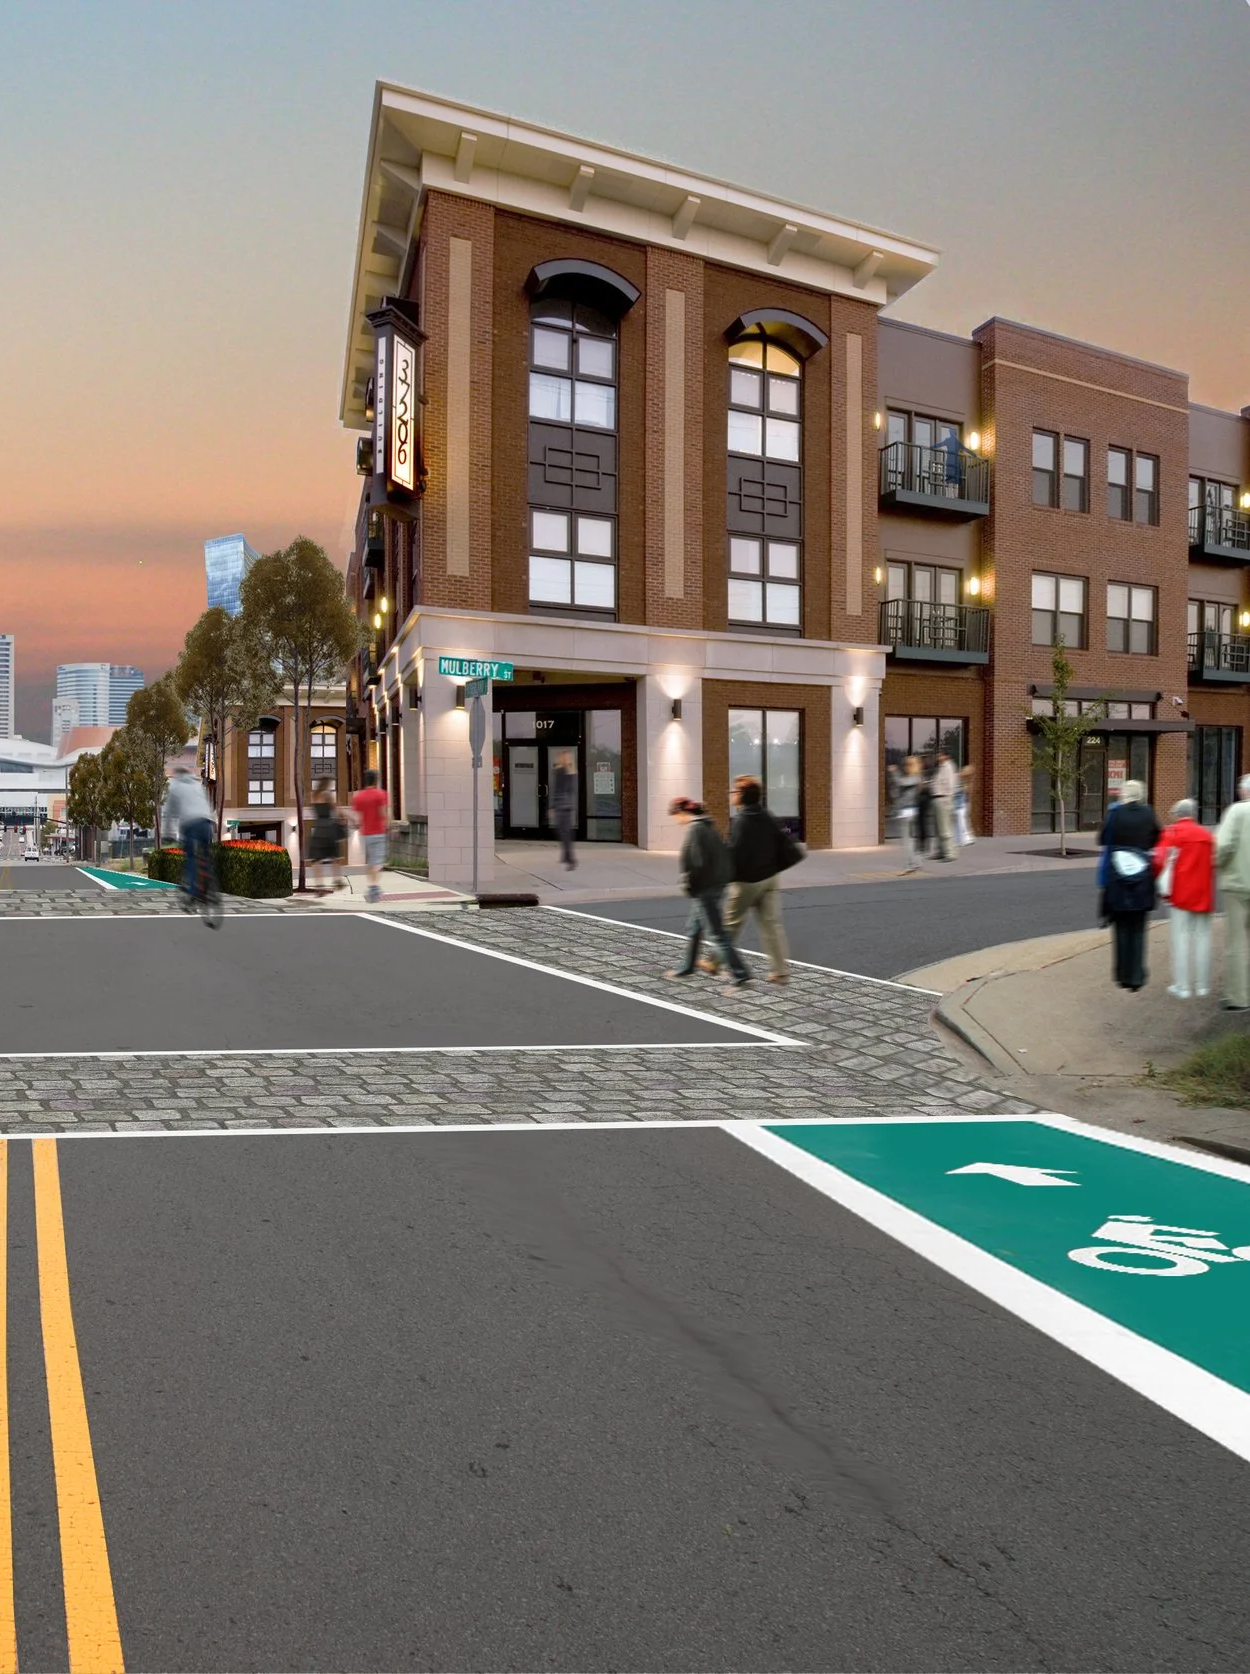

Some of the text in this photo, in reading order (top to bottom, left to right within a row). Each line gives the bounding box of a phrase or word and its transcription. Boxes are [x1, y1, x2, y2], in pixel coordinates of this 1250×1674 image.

[397, 359, 410, 465] 37206
[440, 659, 512, 679] MULBERRY ST
[533, 720, 555, 729] 1017
[1086, 736, 1101, 744] 224
